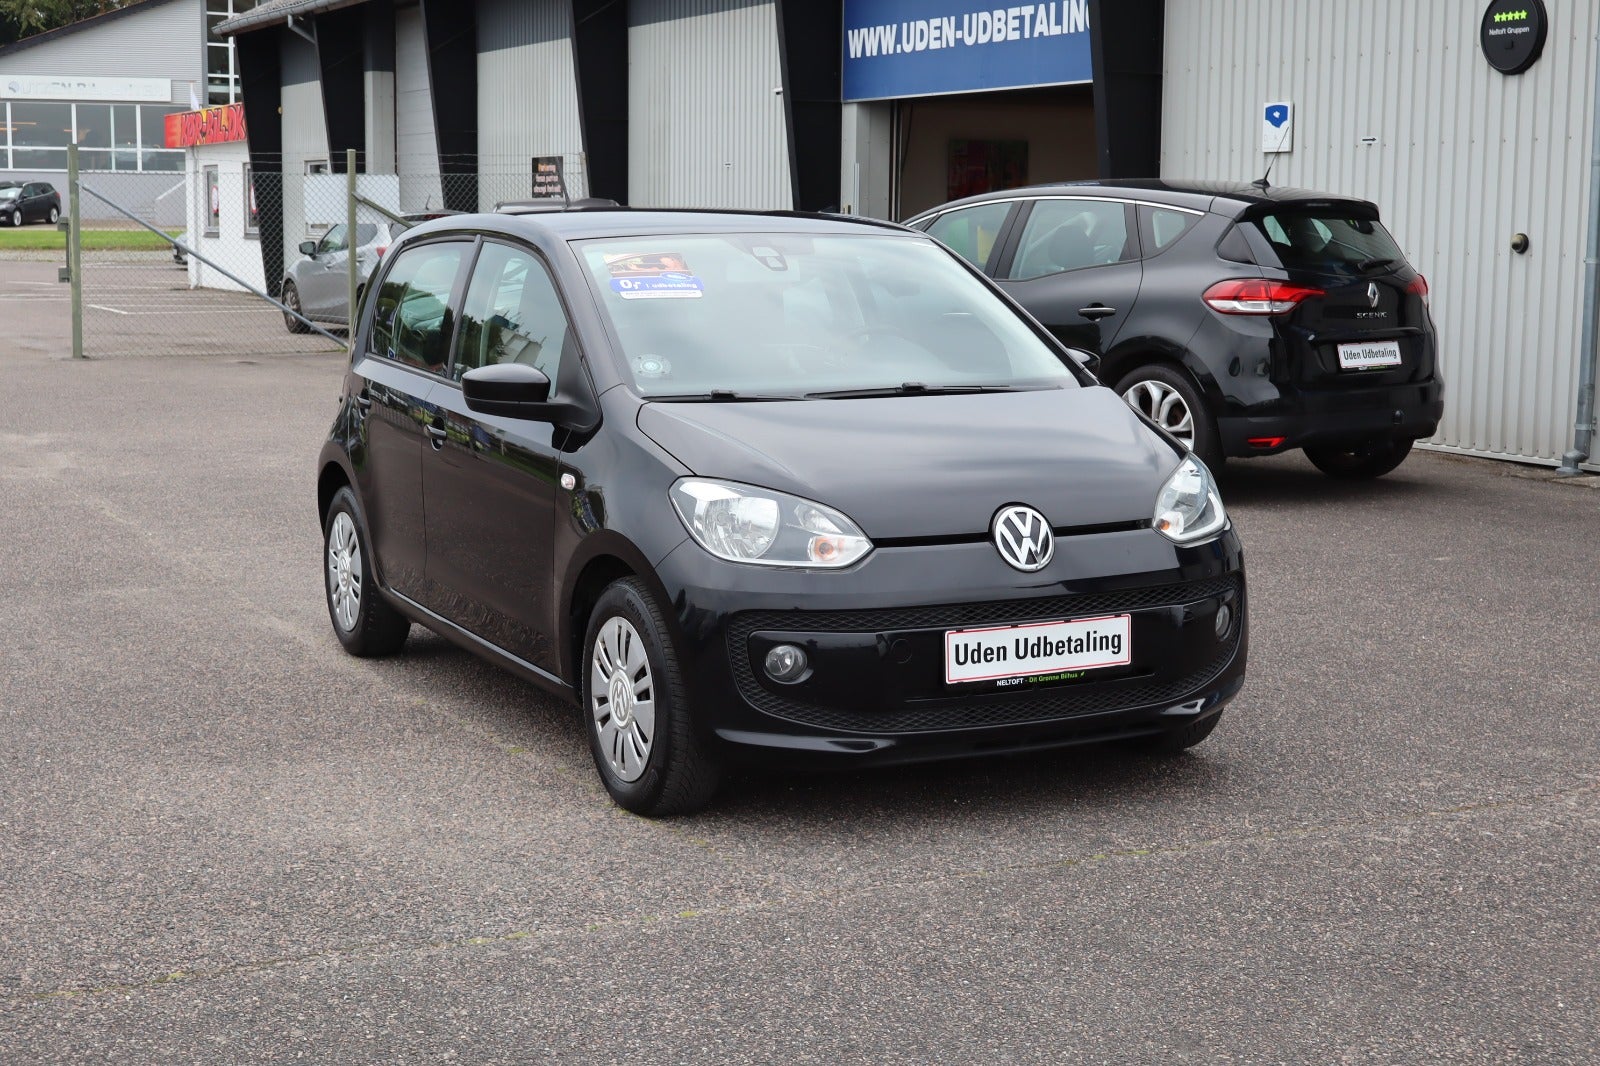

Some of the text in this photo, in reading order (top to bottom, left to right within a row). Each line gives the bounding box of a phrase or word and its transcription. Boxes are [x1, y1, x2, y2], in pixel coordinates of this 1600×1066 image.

[847, 0, 1090, 59] WWW.UDEN-UDBETALIN
[1507, 26, 1530, 35] Gruppen
[1343, 347, 1398, 361] Uden Udbetaling
[954, 630, 1122, 666] Uden Udbetaling
[996, 678, 1024, 686] NELTOFT
